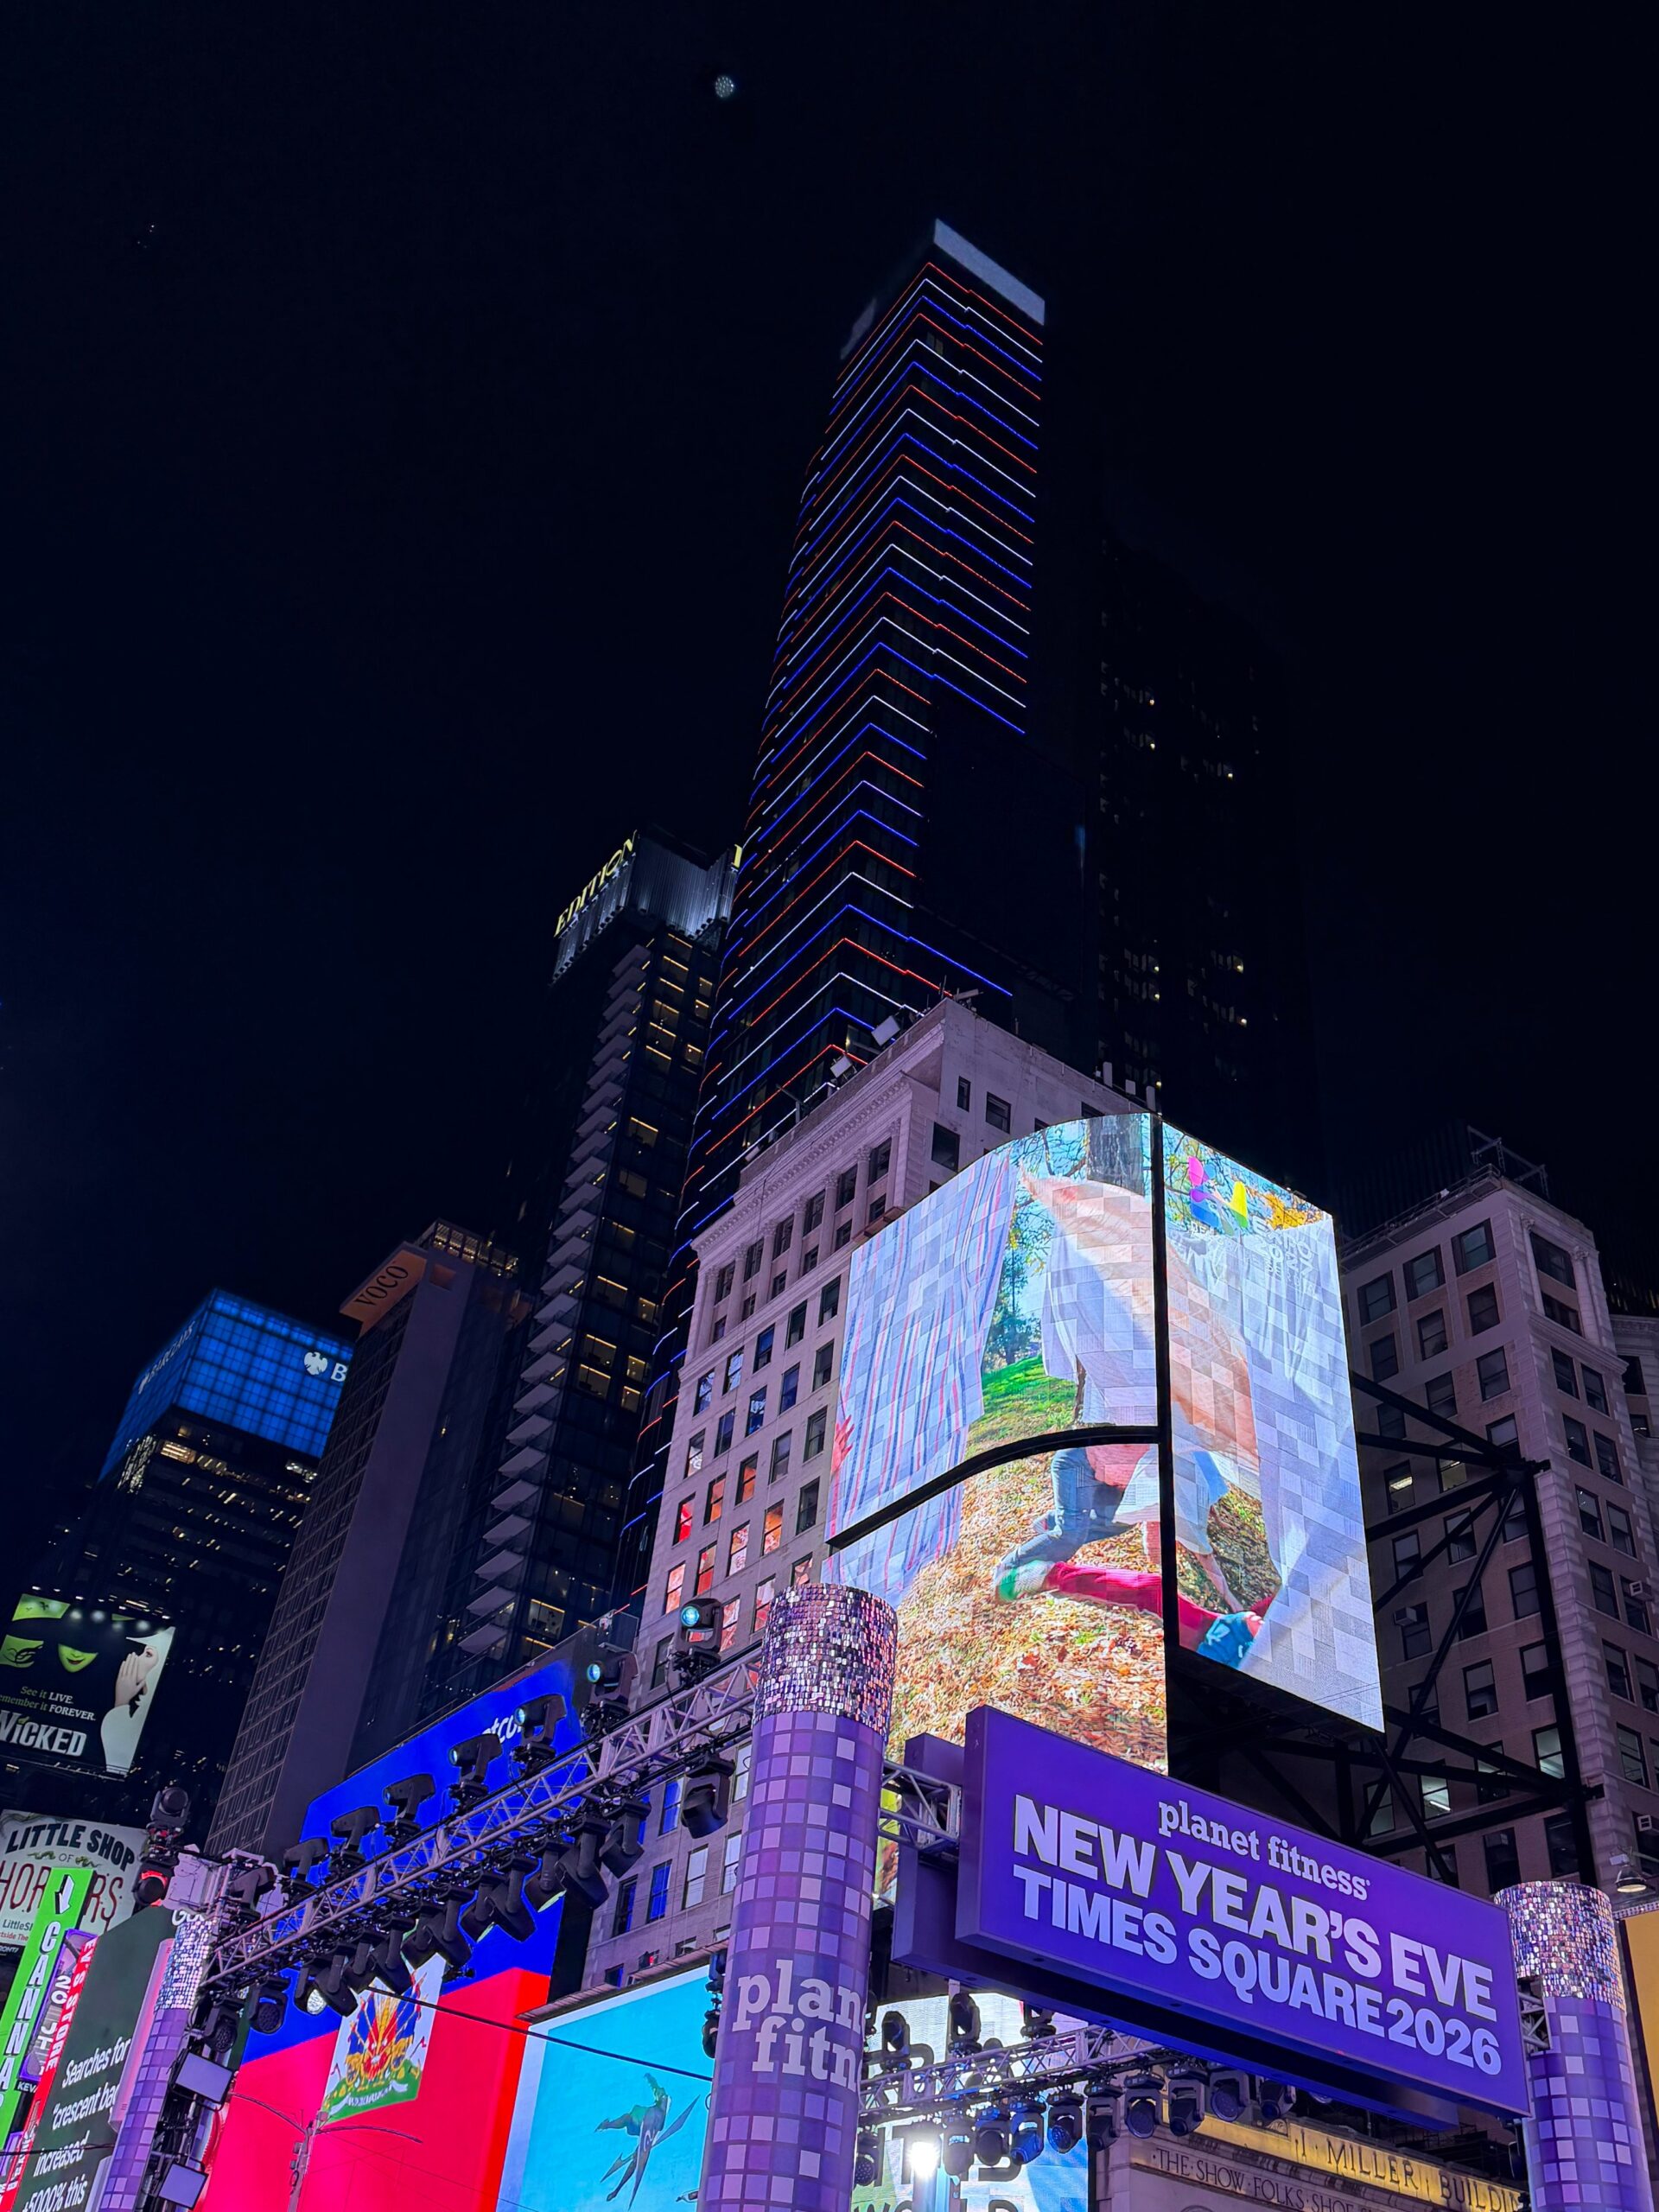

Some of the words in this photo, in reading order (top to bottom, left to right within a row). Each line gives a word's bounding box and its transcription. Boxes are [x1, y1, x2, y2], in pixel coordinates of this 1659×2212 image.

[0, 1694, 38, 1709] emember
[40, 1703, 48, 1712] it
[48, 1704, 96, 1721] FOREVER.
[21, 1686, 38, 1697] See
[40, 1689, 48, 1699] it
[48, 1692, 74, 1705] LIVE.
[5, 1823, 86, 1854] LITTLE
[87, 1829, 136, 1872] SHOP
[59, 1853, 74, 1862] OF
[1159, 1800, 1261, 1862] planet
[1268, 1835, 1370, 1902] fitness
[0, 1860, 124, 1927] HORRS
[1014, 1794, 1157, 1899] NEW
[1166, 1849, 1382, 1979] YEAR’S
[1390, 1932, 1497, 2023] EVE
[1013, 1864, 1178, 1965] TIMES
[1187, 1928, 1385, 2038] SQUARE
[1386, 1998, 1502, 2075] 2026
[0, 1921, 61, 2108] CANNA
[732, 1959, 867, 2035] plan
[62, 2045, 110, 2088] Searches
[110, 2039, 130, 2066] for
[752, 2015, 862, 2093] fitn
[17, 2081, 37, 2093] KEV
[33, 2130, 90, 2177] increased
[1156, 2148, 1190, 2177] THE
[1195, 2159, 1244, 2192] SHOW
[1253, 2177, 1306, 2212] FOLKS
[1326, 2138, 1419, 2191] MILLER
[64, 2173, 88, 2209] this
